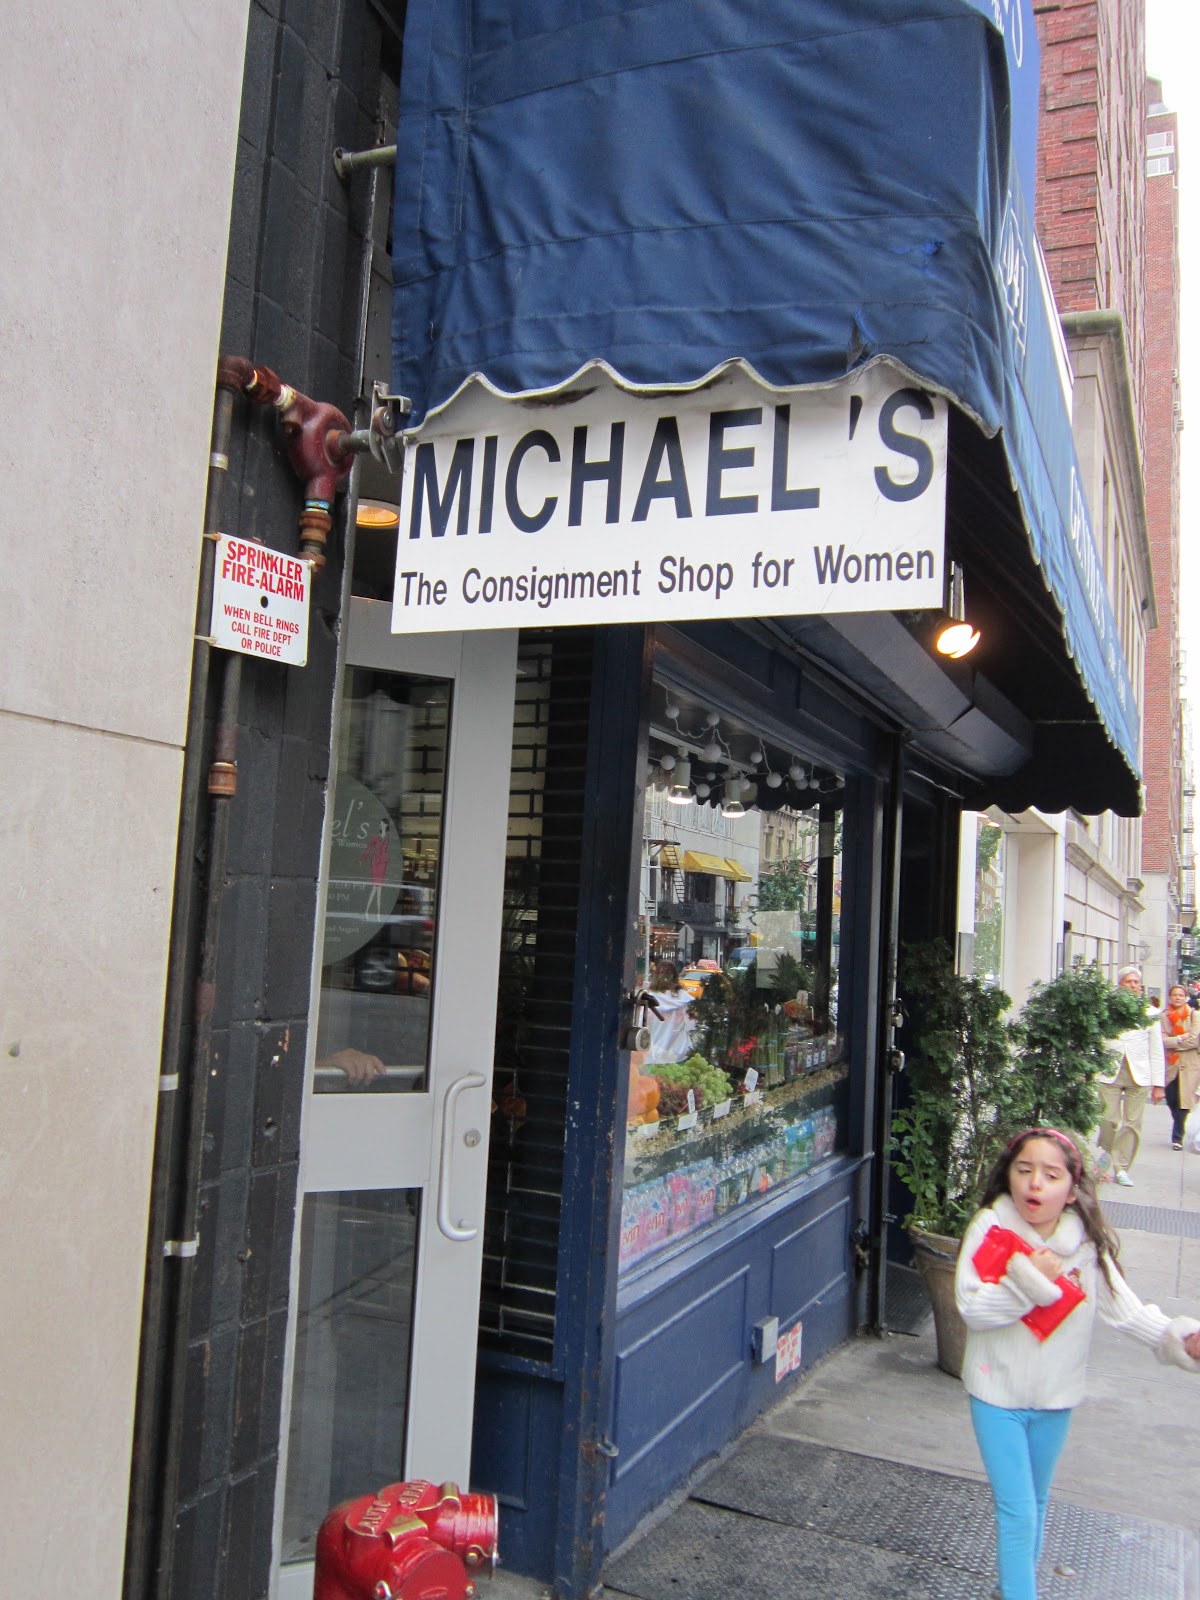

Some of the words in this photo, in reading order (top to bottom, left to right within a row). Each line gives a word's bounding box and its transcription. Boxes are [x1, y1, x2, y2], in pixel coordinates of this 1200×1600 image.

[408, 388, 936, 540] MICHAEL'S
[226, 540, 303, 582] SPRINKLER
[400, 571, 448, 606] The
[462, 560, 641, 609] Consignment
[658, 554, 734, 598] Shop
[752, 551, 795, 588] for
[813, 543, 935, 585] Women
[221, 559, 305, 602] FIRE-ALARM
[223, 604, 251, 621] WHEN
[253, 612, 273, 628] BELL
[275, 618, 300, 634] RINGS
[231, 620, 252, 636] CALL
[253, 627, 271, 641] FIRE
[272, 631, 292, 646] DEPT
[241, 637, 252, 650] OR
[254, 641, 282, 657] POLICE
[336, 838, 368, 849] Women
